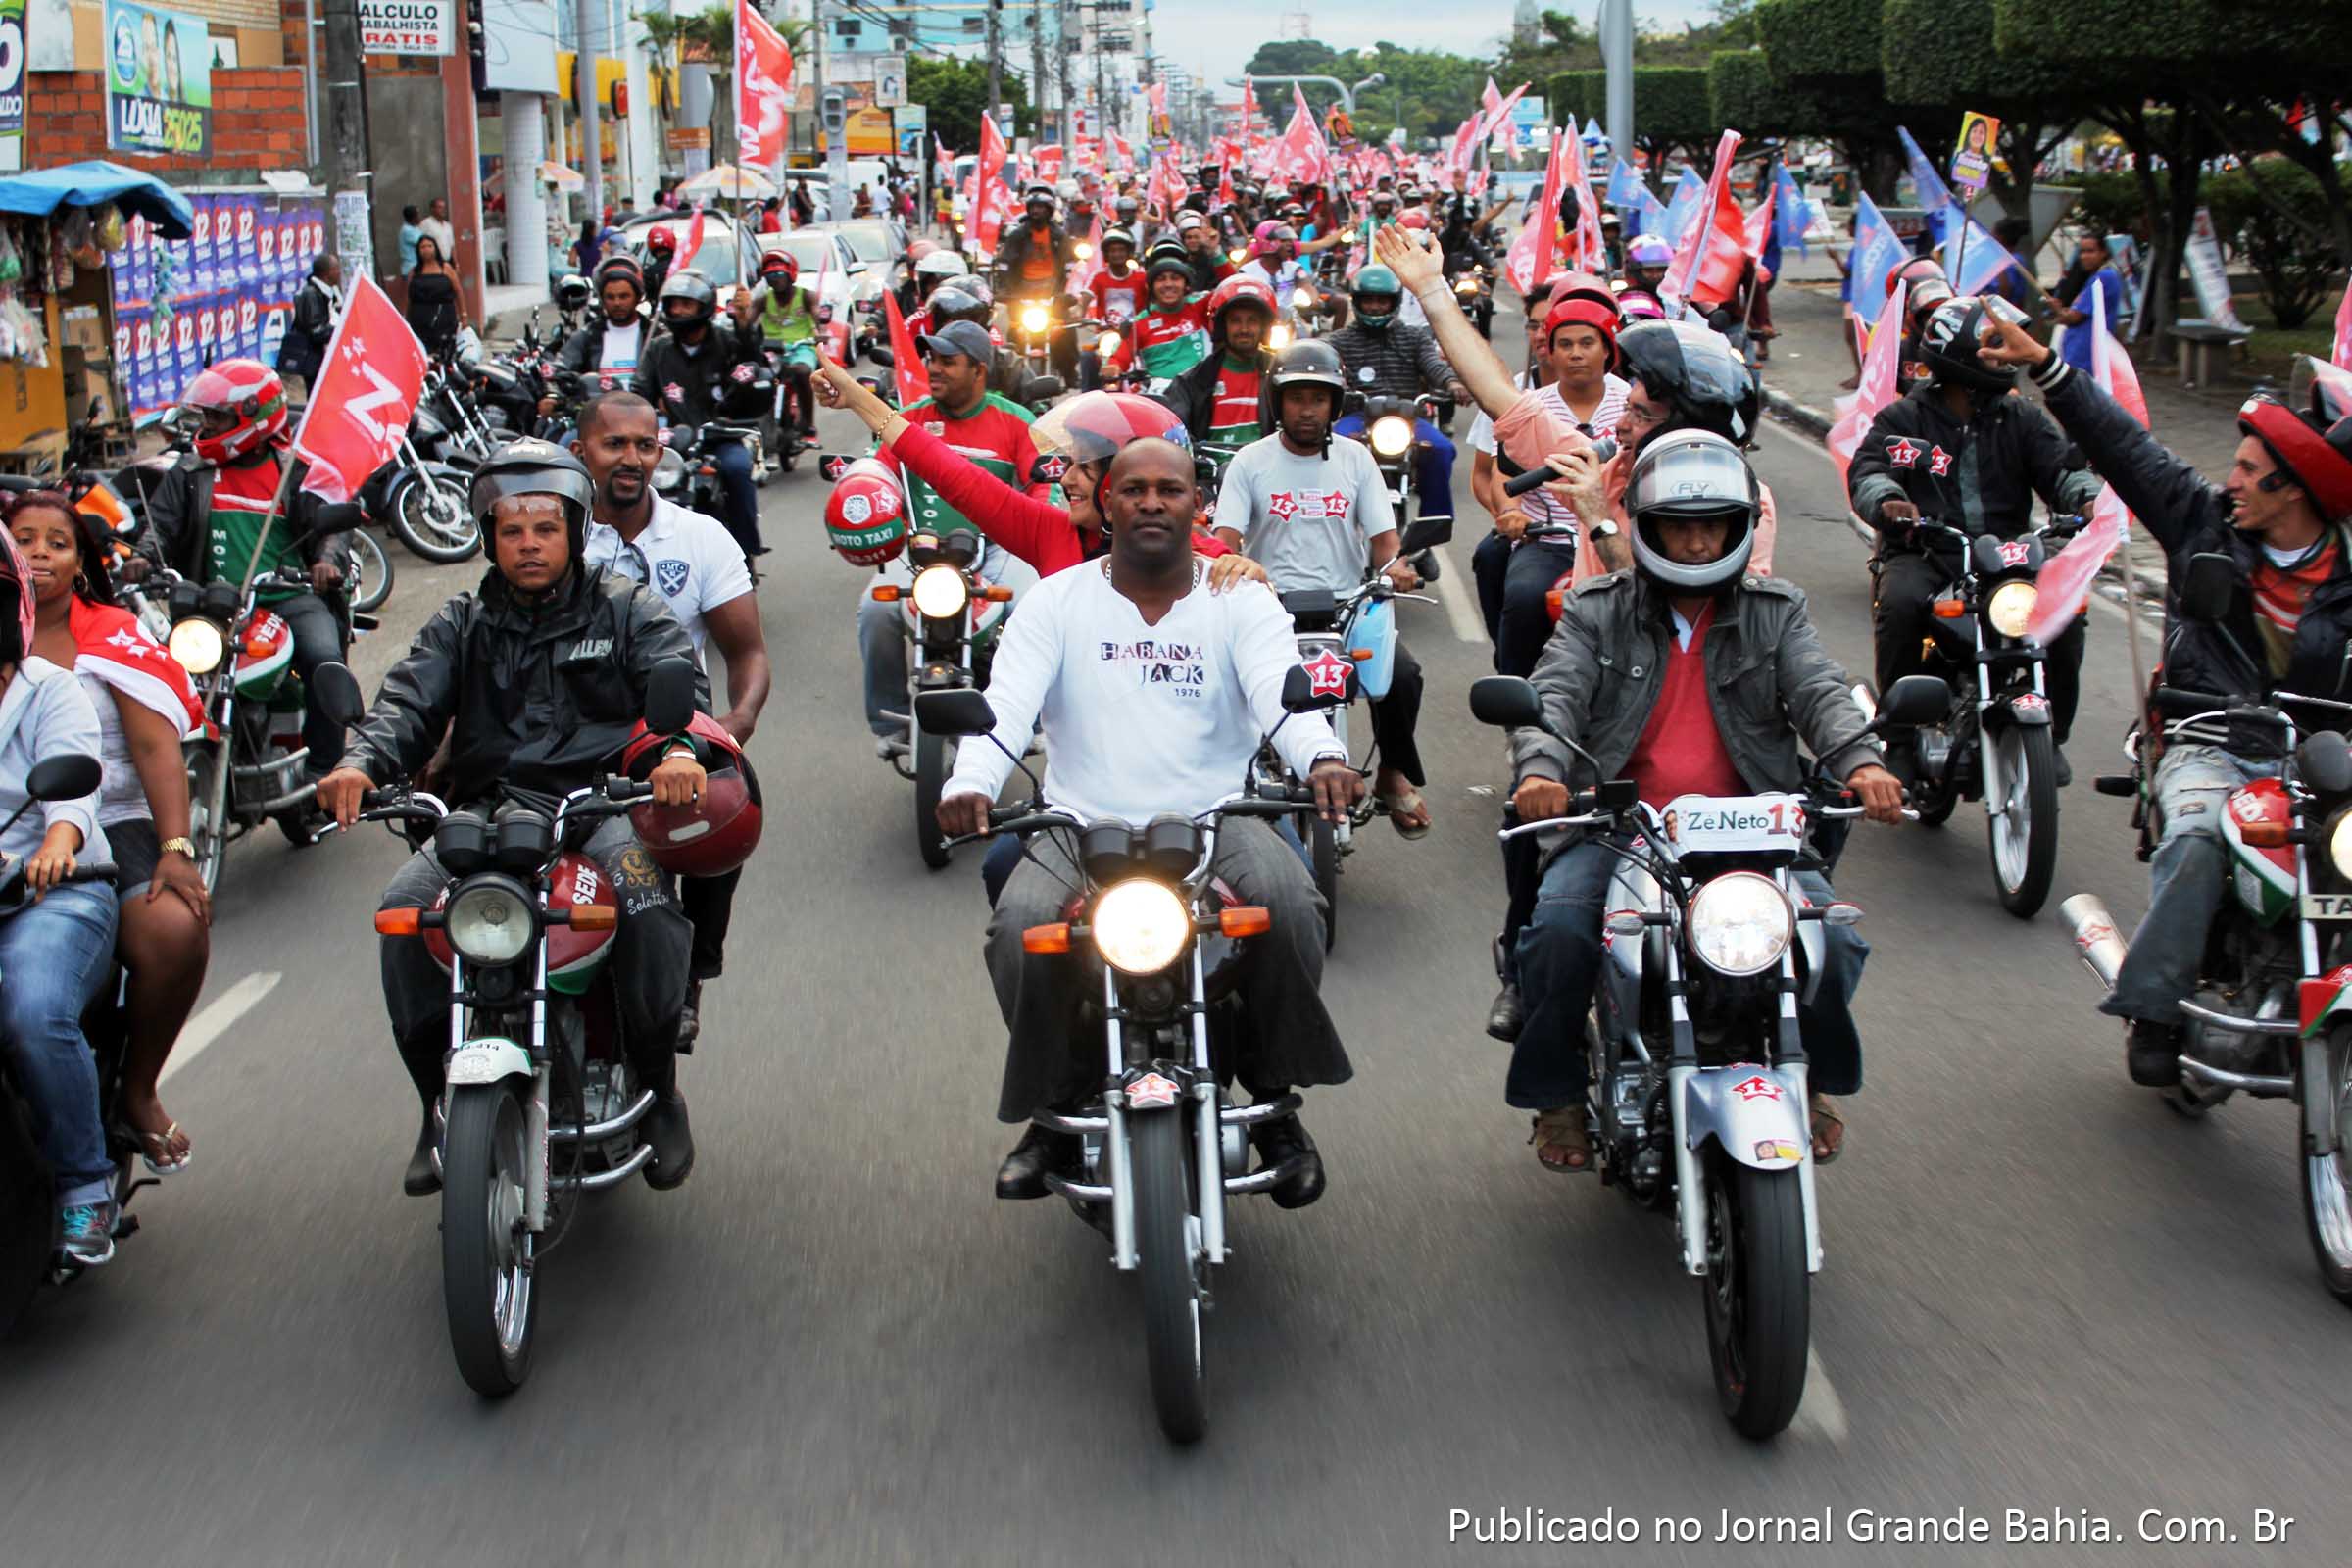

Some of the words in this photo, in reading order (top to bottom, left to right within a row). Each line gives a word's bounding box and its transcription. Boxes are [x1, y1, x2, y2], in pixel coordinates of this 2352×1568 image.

[359, 4, 438, 19] ALCULO
[1891, 449, 1914, 464] 13
[1932, 455, 1946, 469] 3
[1679, 482, 1709, 494] FLY
[1275, 498, 1295, 514] 13
[1328, 498, 1346, 514] 13
[830, 532, 862, 546] MOTO
[865, 527, 893, 545] TAXI
[1101, 642, 1203, 661] HABANA
[1140, 663, 1204, 686] JACK
[1313, 664, 1343, 688] 13
[1175, 688, 1200, 699] 1976
[1688, 811, 1715, 831] Zé
[1718, 810, 1770, 831] Neto
[1767, 803, 1805, 839] 13
[572, 863, 599, 905] SEDE
[1742, 1083, 1776, 1096] 13
